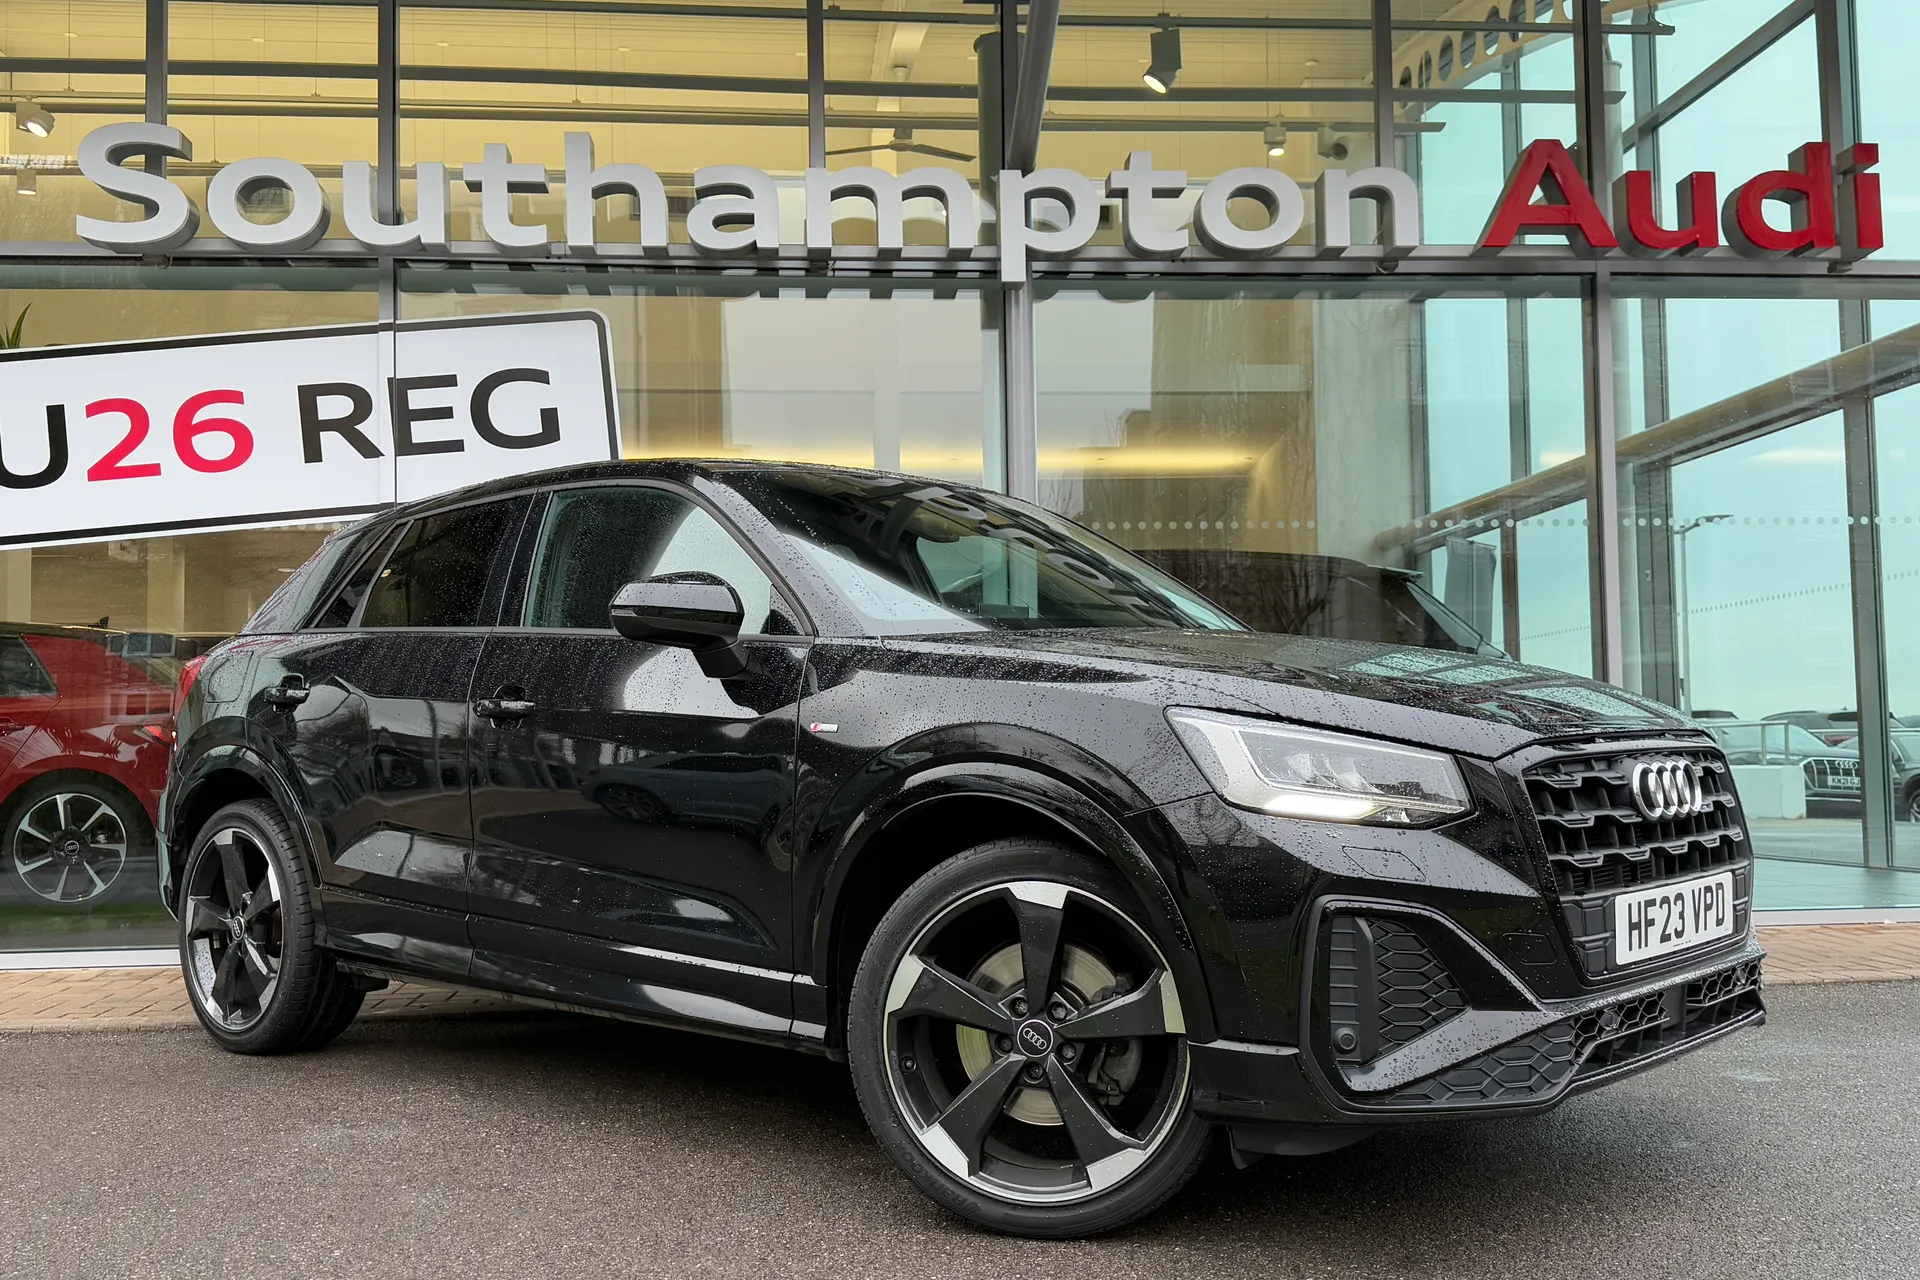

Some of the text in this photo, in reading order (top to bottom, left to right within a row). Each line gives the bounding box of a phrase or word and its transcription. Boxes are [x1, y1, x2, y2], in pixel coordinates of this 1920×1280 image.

[76, 121, 1884, 284] Southampton Audi
[0, 367, 562, 489] U26 REG
[1627, 881, 1725, 952] HF23 VPD
